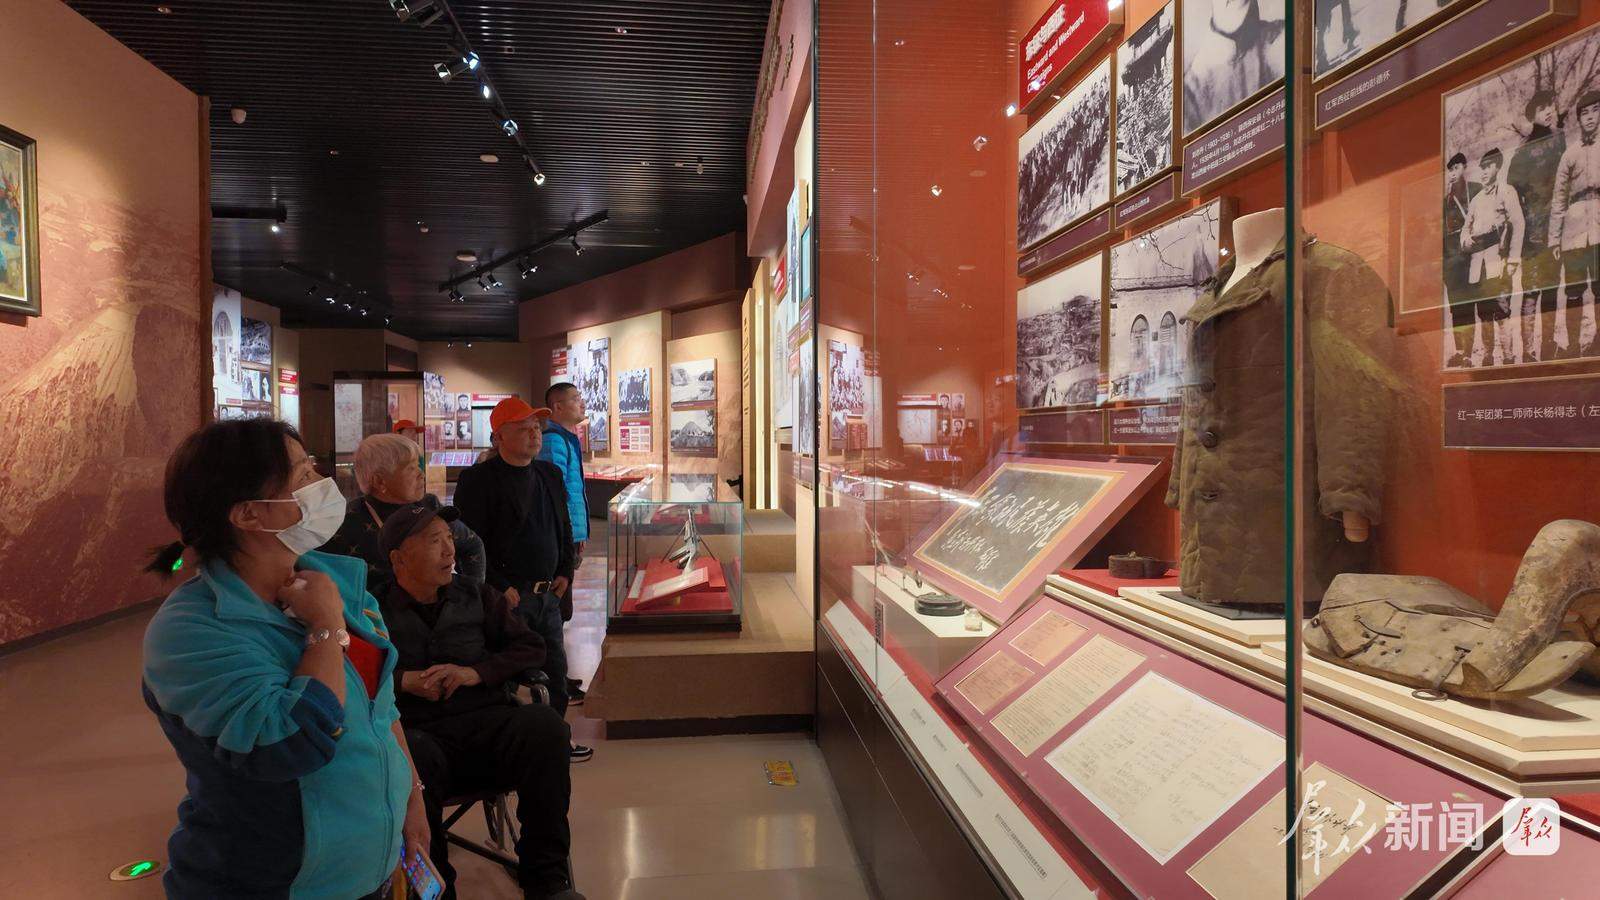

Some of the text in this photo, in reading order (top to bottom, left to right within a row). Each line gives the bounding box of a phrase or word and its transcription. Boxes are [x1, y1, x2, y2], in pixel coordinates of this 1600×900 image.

[1027, 11, 1085, 79] Eastward and Westward
[1027, 63, 1053, 93] Caigns
